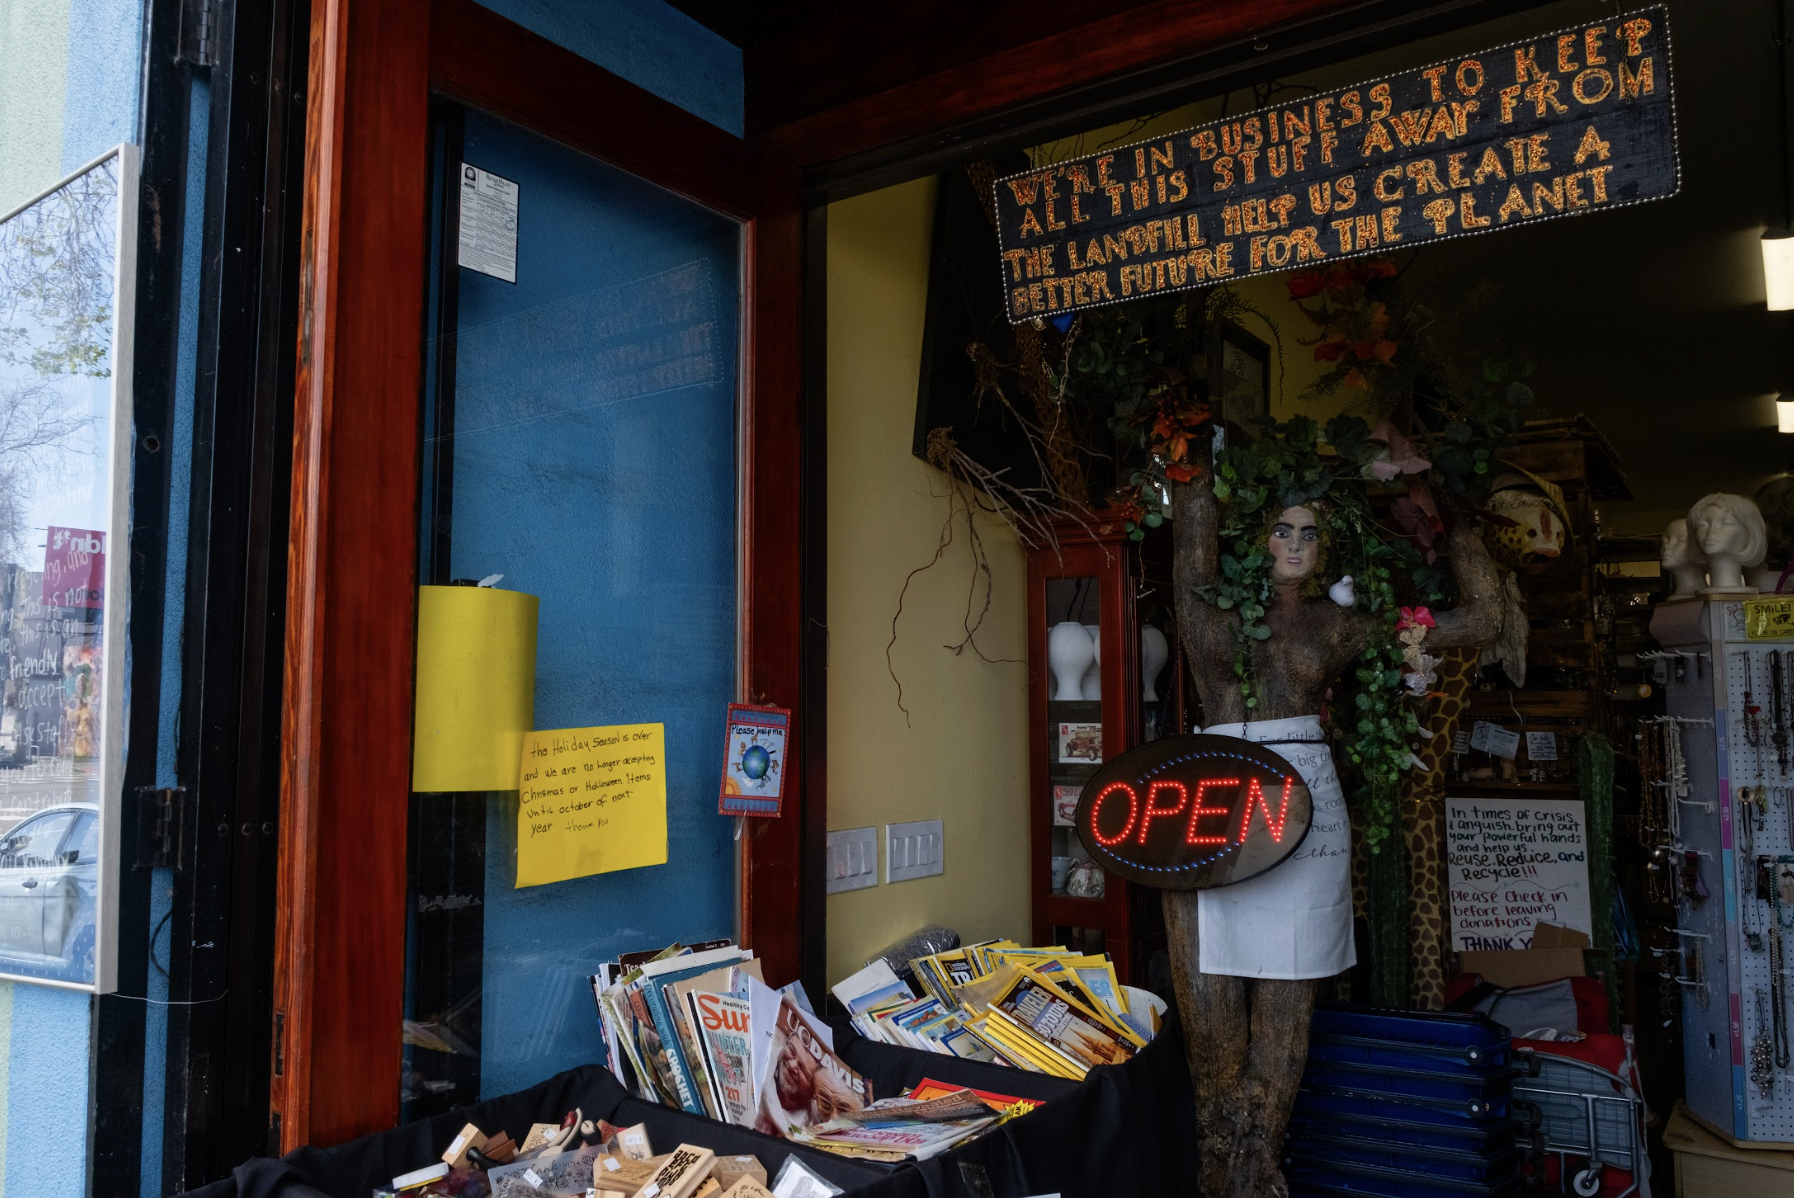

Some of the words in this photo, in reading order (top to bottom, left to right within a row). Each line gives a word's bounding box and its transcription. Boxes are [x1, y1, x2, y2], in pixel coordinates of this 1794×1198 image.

[1007, 154, 1116, 206] WE'RE
[1135, 141, 1174, 179] IN
[1190, 83, 1393, 162] BUSINESS
[1423, 59, 1485, 102] TO
[1514, 17, 1652, 83] KEEP
[1020, 194, 1090, 239] ALL
[1105, 170, 1189, 217] THIS
[1212, 130, 1340, 192] STUFF
[1361, 100, 1480, 157] AWAY
[1499, 56, 1655, 124] FROM
[1003, 245, 1055, 282] THE
[1067, 213, 1206, 271] LANDFILL
[1221, 194, 1297, 236] HELP
[1308, 175, 1357, 216] US
[1374, 132, 1551, 202] CREATE
[1573, 124, 1611, 165] A
[1011, 270, 1116, 316] BETTER
[1120, 242, 1235, 297] FUTURE
[1250, 226, 1327, 273] FOR
[1331, 207, 1402, 254] THE
[1422, 165, 1613, 235] PLANET
[10, 648, 58, 680] friendly
[731, 726, 755, 735] Please
[756, 727, 771, 736] help
[553, 736, 591, 756] Holiday
[593, 731, 620, 748] Season
[623, 733, 629, 742] is
[632, 730, 653, 741] over
[1296, 754, 1318, 768] big
[524, 770, 539, 782] and
[561, 766, 576, 776] are
[569, 785, 578, 794] or
[586, 778, 622, 791] Halloween
[596, 794, 607, 808] of
[612, 790, 634, 803] next
[1091, 776, 1293, 845] OPEN
[1451, 807, 1467, 819] In
[1471, 806, 1511, 820] times
[1517, 810, 1530, 819] of
[1535, 811, 1573, 823] crisis
[1516, 821, 1554, 835] bring
[1557, 821, 1581, 833] out
[1449, 832, 1477, 843] your
[1483, 832, 1537, 843] powerful
[1541, 832, 1582, 844] hands
[1456, 844, 1479, 852] and
[1483, 843, 1510, 854] help
[1558, 851, 1585, 862] and
[1451, 890, 1499, 903] Please
[1551, 890, 1568, 902] in
[1453, 905, 1500, 917] before
[1505, 903, 1557, 920] leaving
[1460, 936, 1514, 950] THANK
[660, 1027, 669, 1046] with
[666, 1048, 694, 1108] CROCHET
